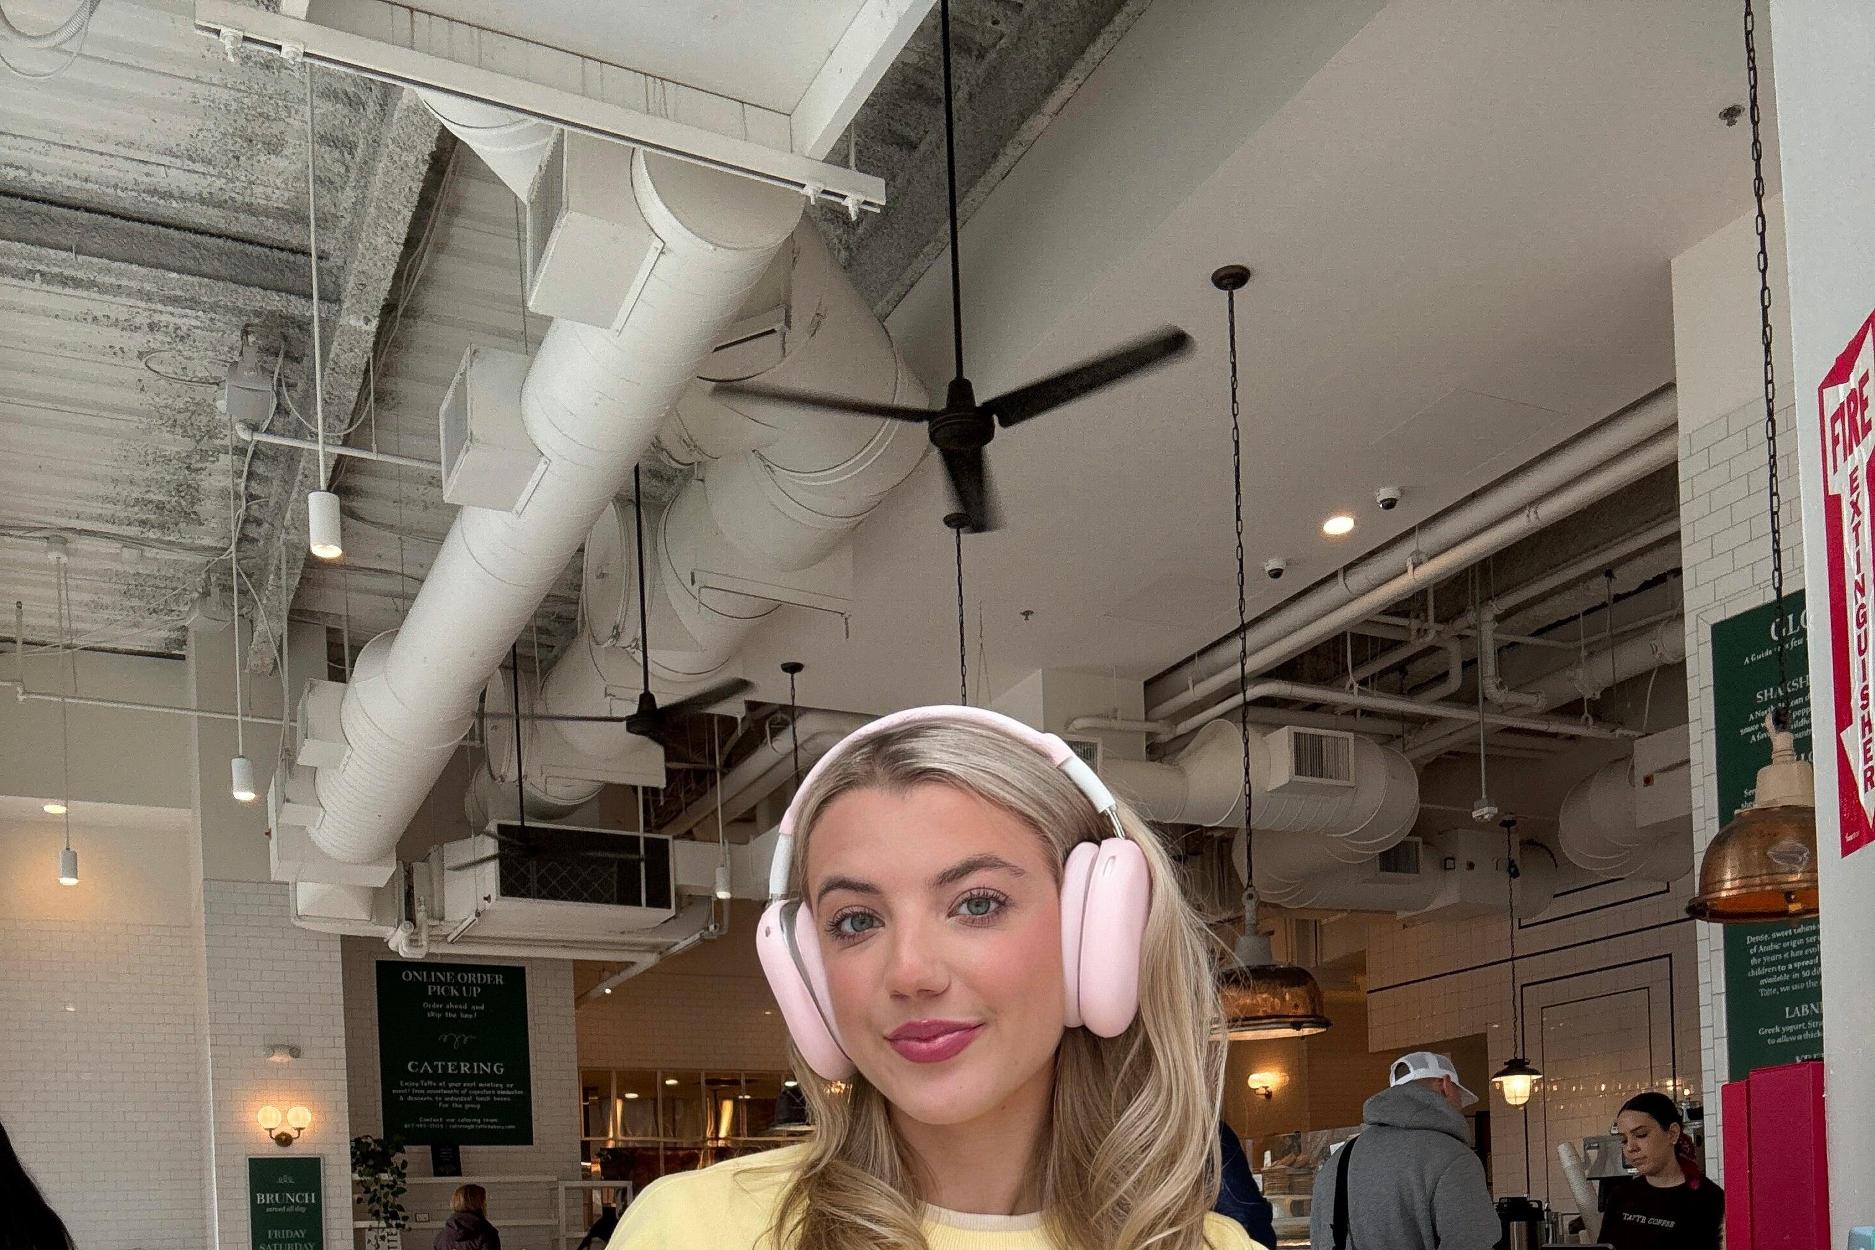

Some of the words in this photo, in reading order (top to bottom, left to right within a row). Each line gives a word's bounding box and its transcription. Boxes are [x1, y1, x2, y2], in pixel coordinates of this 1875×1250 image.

[1830, 368, 1872, 476] FIRE
[1848, 465, 1875, 795] EXTINGUISHER
[401, 969, 455, 984] ONLINE
[457, 971, 504, 985] ORDER
[407, 1061, 505, 1075] CATERING
[256, 1192, 316, 1205] BRUNCH
[267, 1229, 307, 1240] FRIDAY
